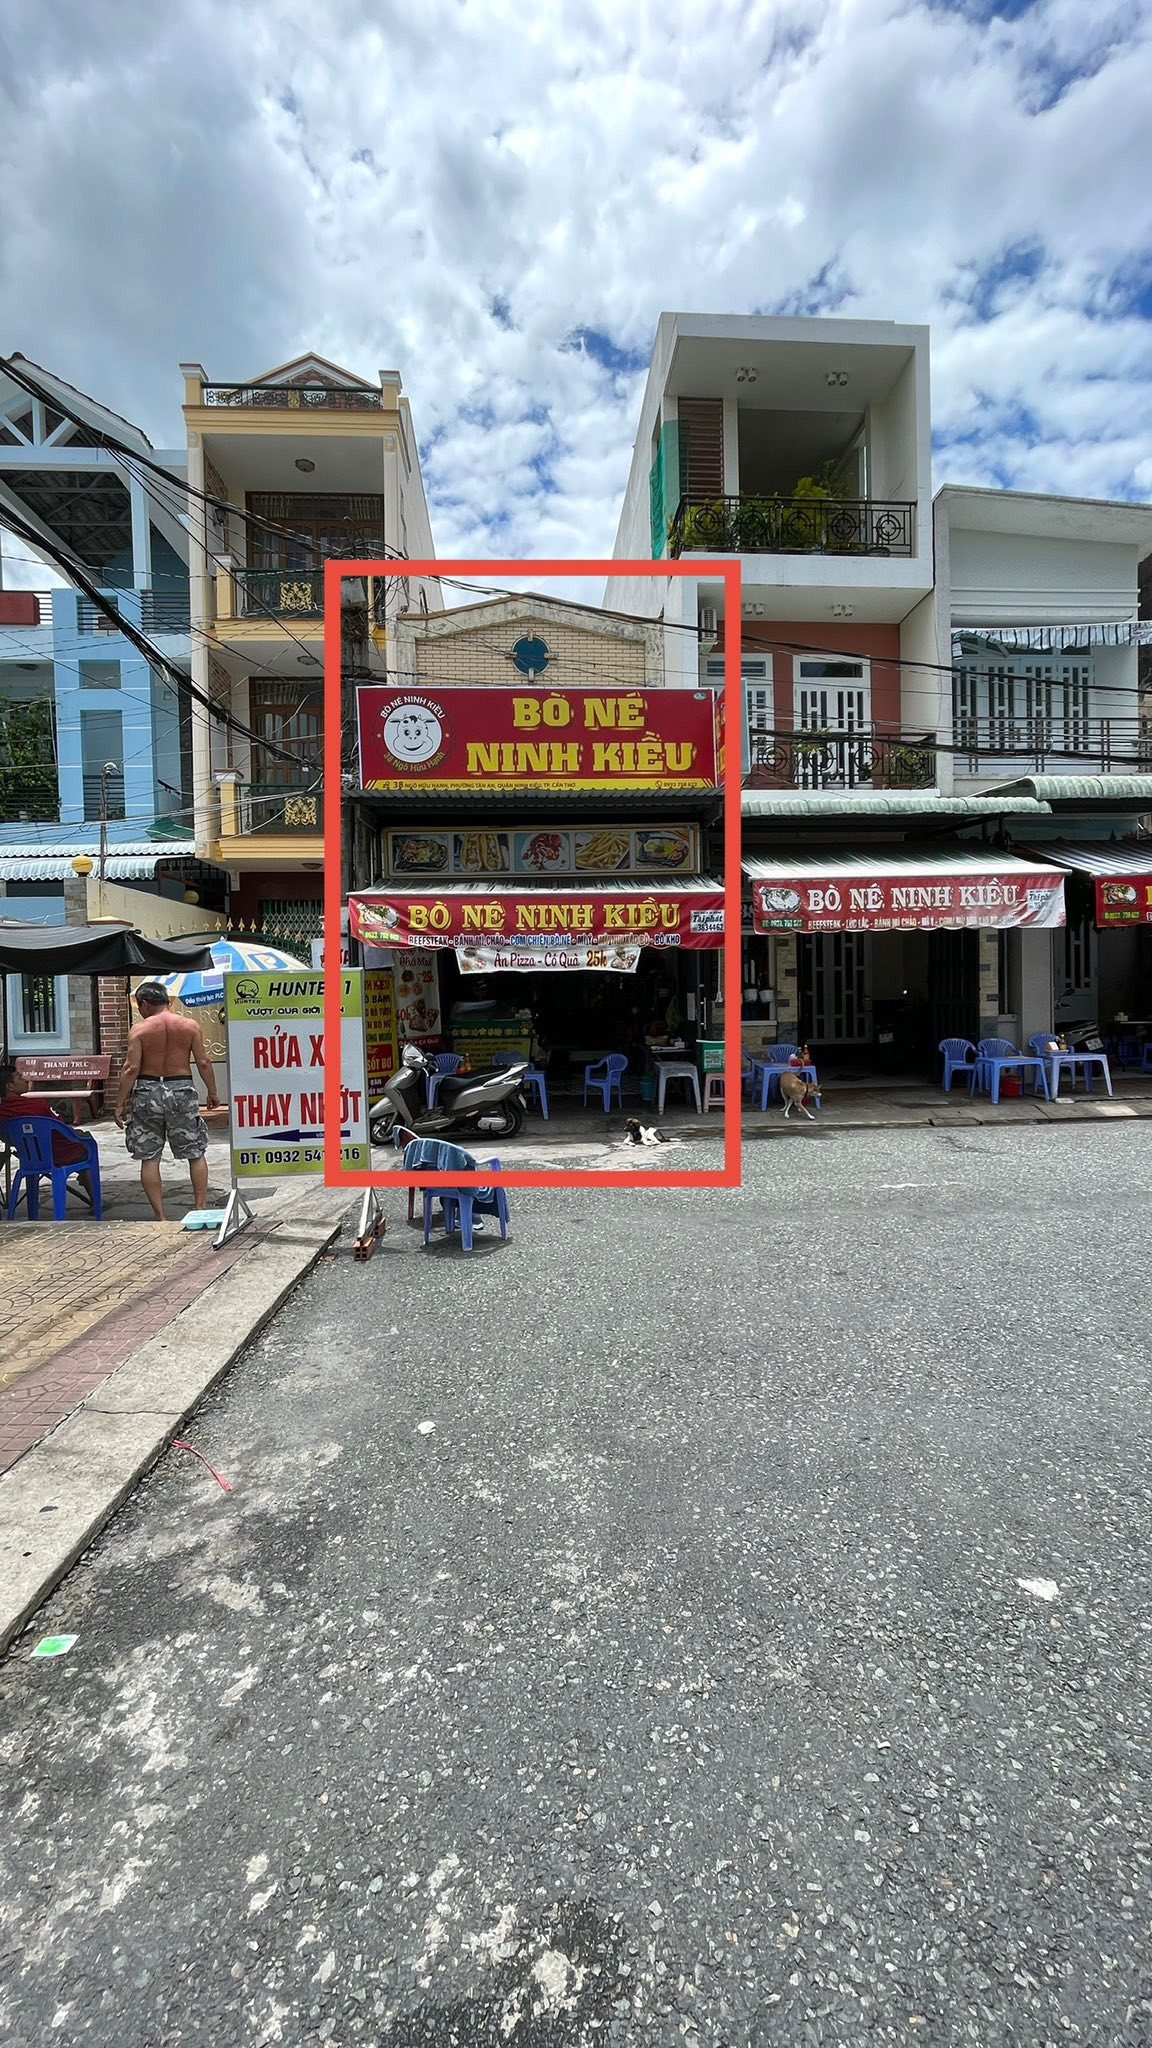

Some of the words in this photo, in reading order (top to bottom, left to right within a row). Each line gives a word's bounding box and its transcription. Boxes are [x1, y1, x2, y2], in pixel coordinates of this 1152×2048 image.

[380, 705, 392, 719] BÒ
[390, 697, 404, 708] NÉ
[404, 696, 427, 705] NINH
[427, 700, 445, 719] KIỀU
[513, 692, 571, 728] BÒ
[584, 692, 645, 728] NÉ
[466, 742, 580, 772] NINH
[592, 731, 694, 772] KIỀU
[393, 781, 404, 789] 38
[807, 884, 842, 912] BÒ
[849, 883, 884, 912] NÉ
[891, 887, 953, 910] NINH
[959, 877, 1019, 909] KIỀU
[408, 901, 451, 930] BÒ
[462, 900, 506, 931] NÉ
[516, 904, 595, 931] NINH
[603, 897, 681, 931] KIỀU
[808, 919, 841, 930] BEEFSTEAK
[875, 917, 891, 929] BÁNH
[409, 936, 448, 946] BEEFSTEAK
[455, 934, 473, 946] BÁNH
[474, 934, 485, 946] MÌ
[486, 932, 505, 946] CHẢO
[510, 934, 528, 946] CƠM
[528, 933, 550, 946] CHIÊN
[551, 933, 561, 945] BÒ
[562, 933, 572, 945] NÉ
[655, 933, 665, 945] BÒ
[666, 934, 680, 945] KHO
[494, 949, 508, 967] Ăn
[510, 952, 536, 967] Pizza
[545, 951, 557, 967] Có
[559, 951, 580, 968] Quà
[586, 951, 607, 967] 25k
[268, 981, 325, 997] HUNTE
[345, 981, 352, 995] 1
[246, 1007, 274, 1016] VƯỢT
[278, 1007, 298, 1015] QUA
[302, 1006, 321, 1014] GIỚI
[253, 1024, 302, 1069] RỬA
[309, 1035, 325, 1067] X
[234, 1093, 292, 1128] THAY
[240, 1152, 260, 1165] ĐT:
[265, 1150, 300, 1164] 0932
[340, 1148, 360, 1160] 16
